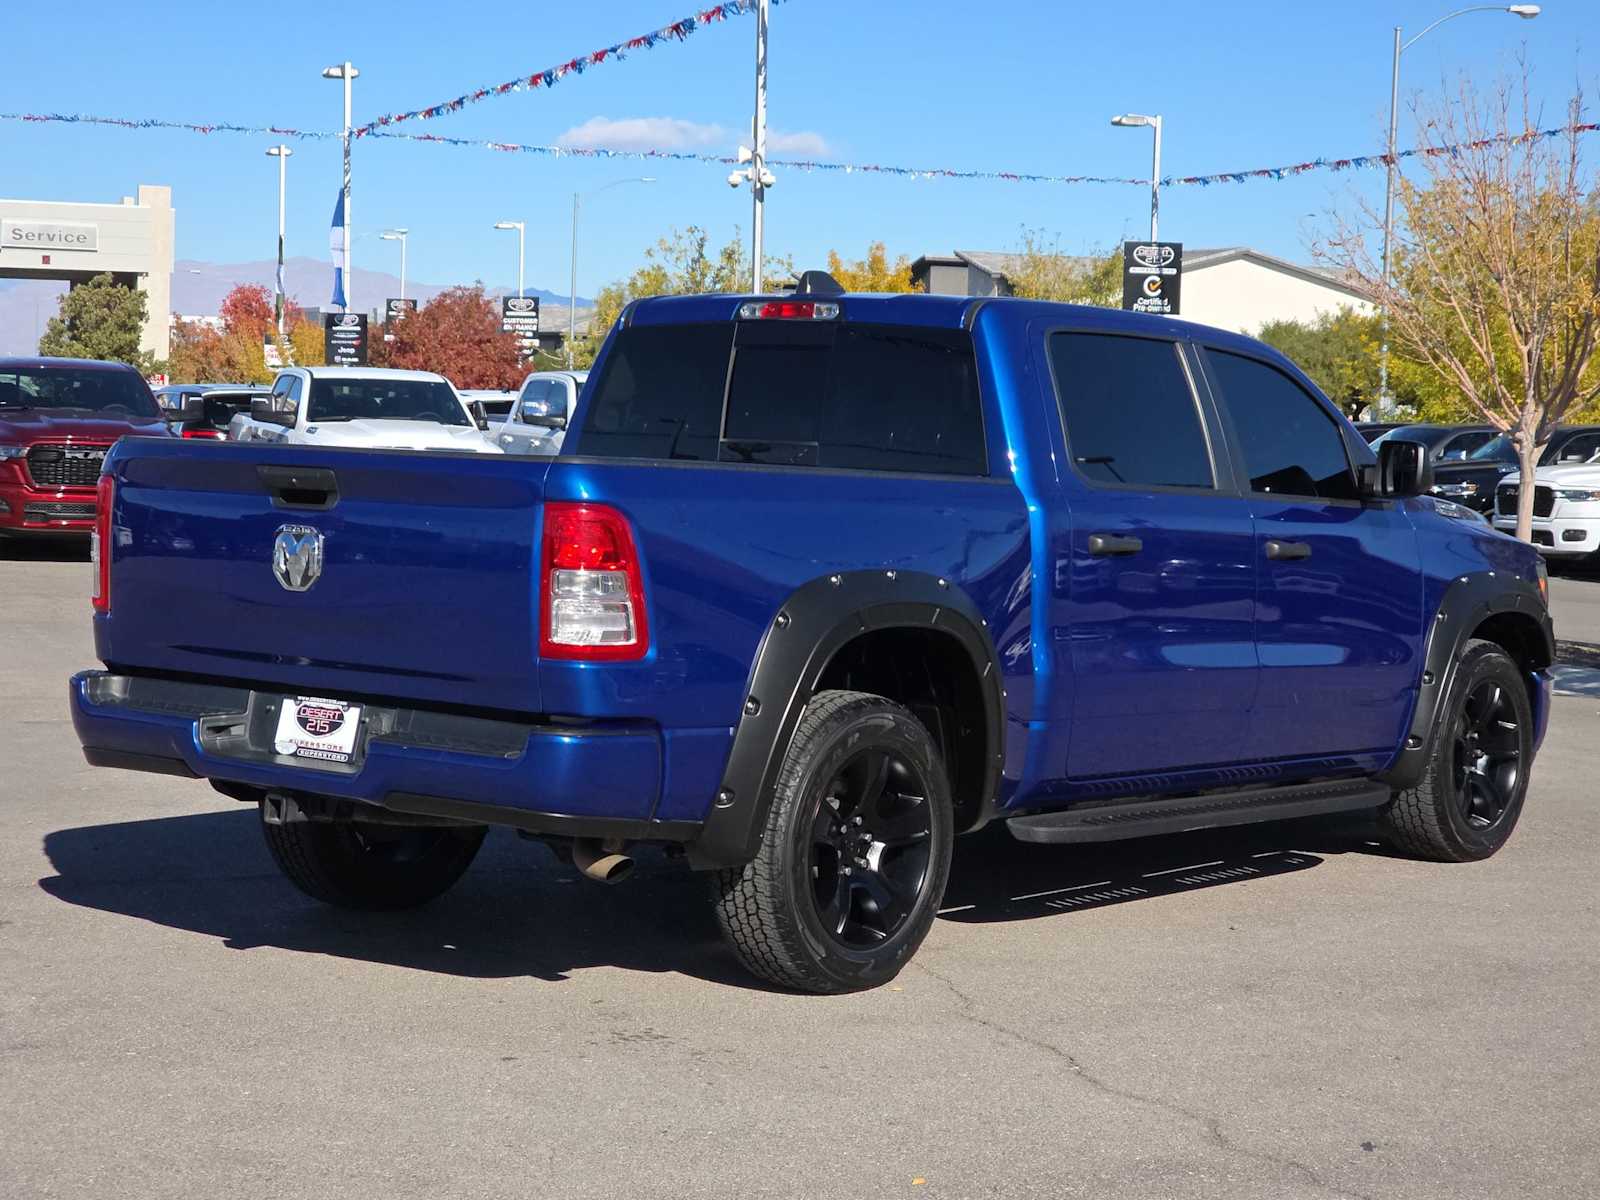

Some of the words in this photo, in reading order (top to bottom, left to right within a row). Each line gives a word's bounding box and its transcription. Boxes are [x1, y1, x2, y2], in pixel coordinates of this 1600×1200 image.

[11, 227, 88, 244] Service
[338, 346, 355, 355] Jeep
[300, 707, 341, 720] DESERT
[306, 719, 329, 732] 215
[289, 739, 344, 751] SUPERSTORE
